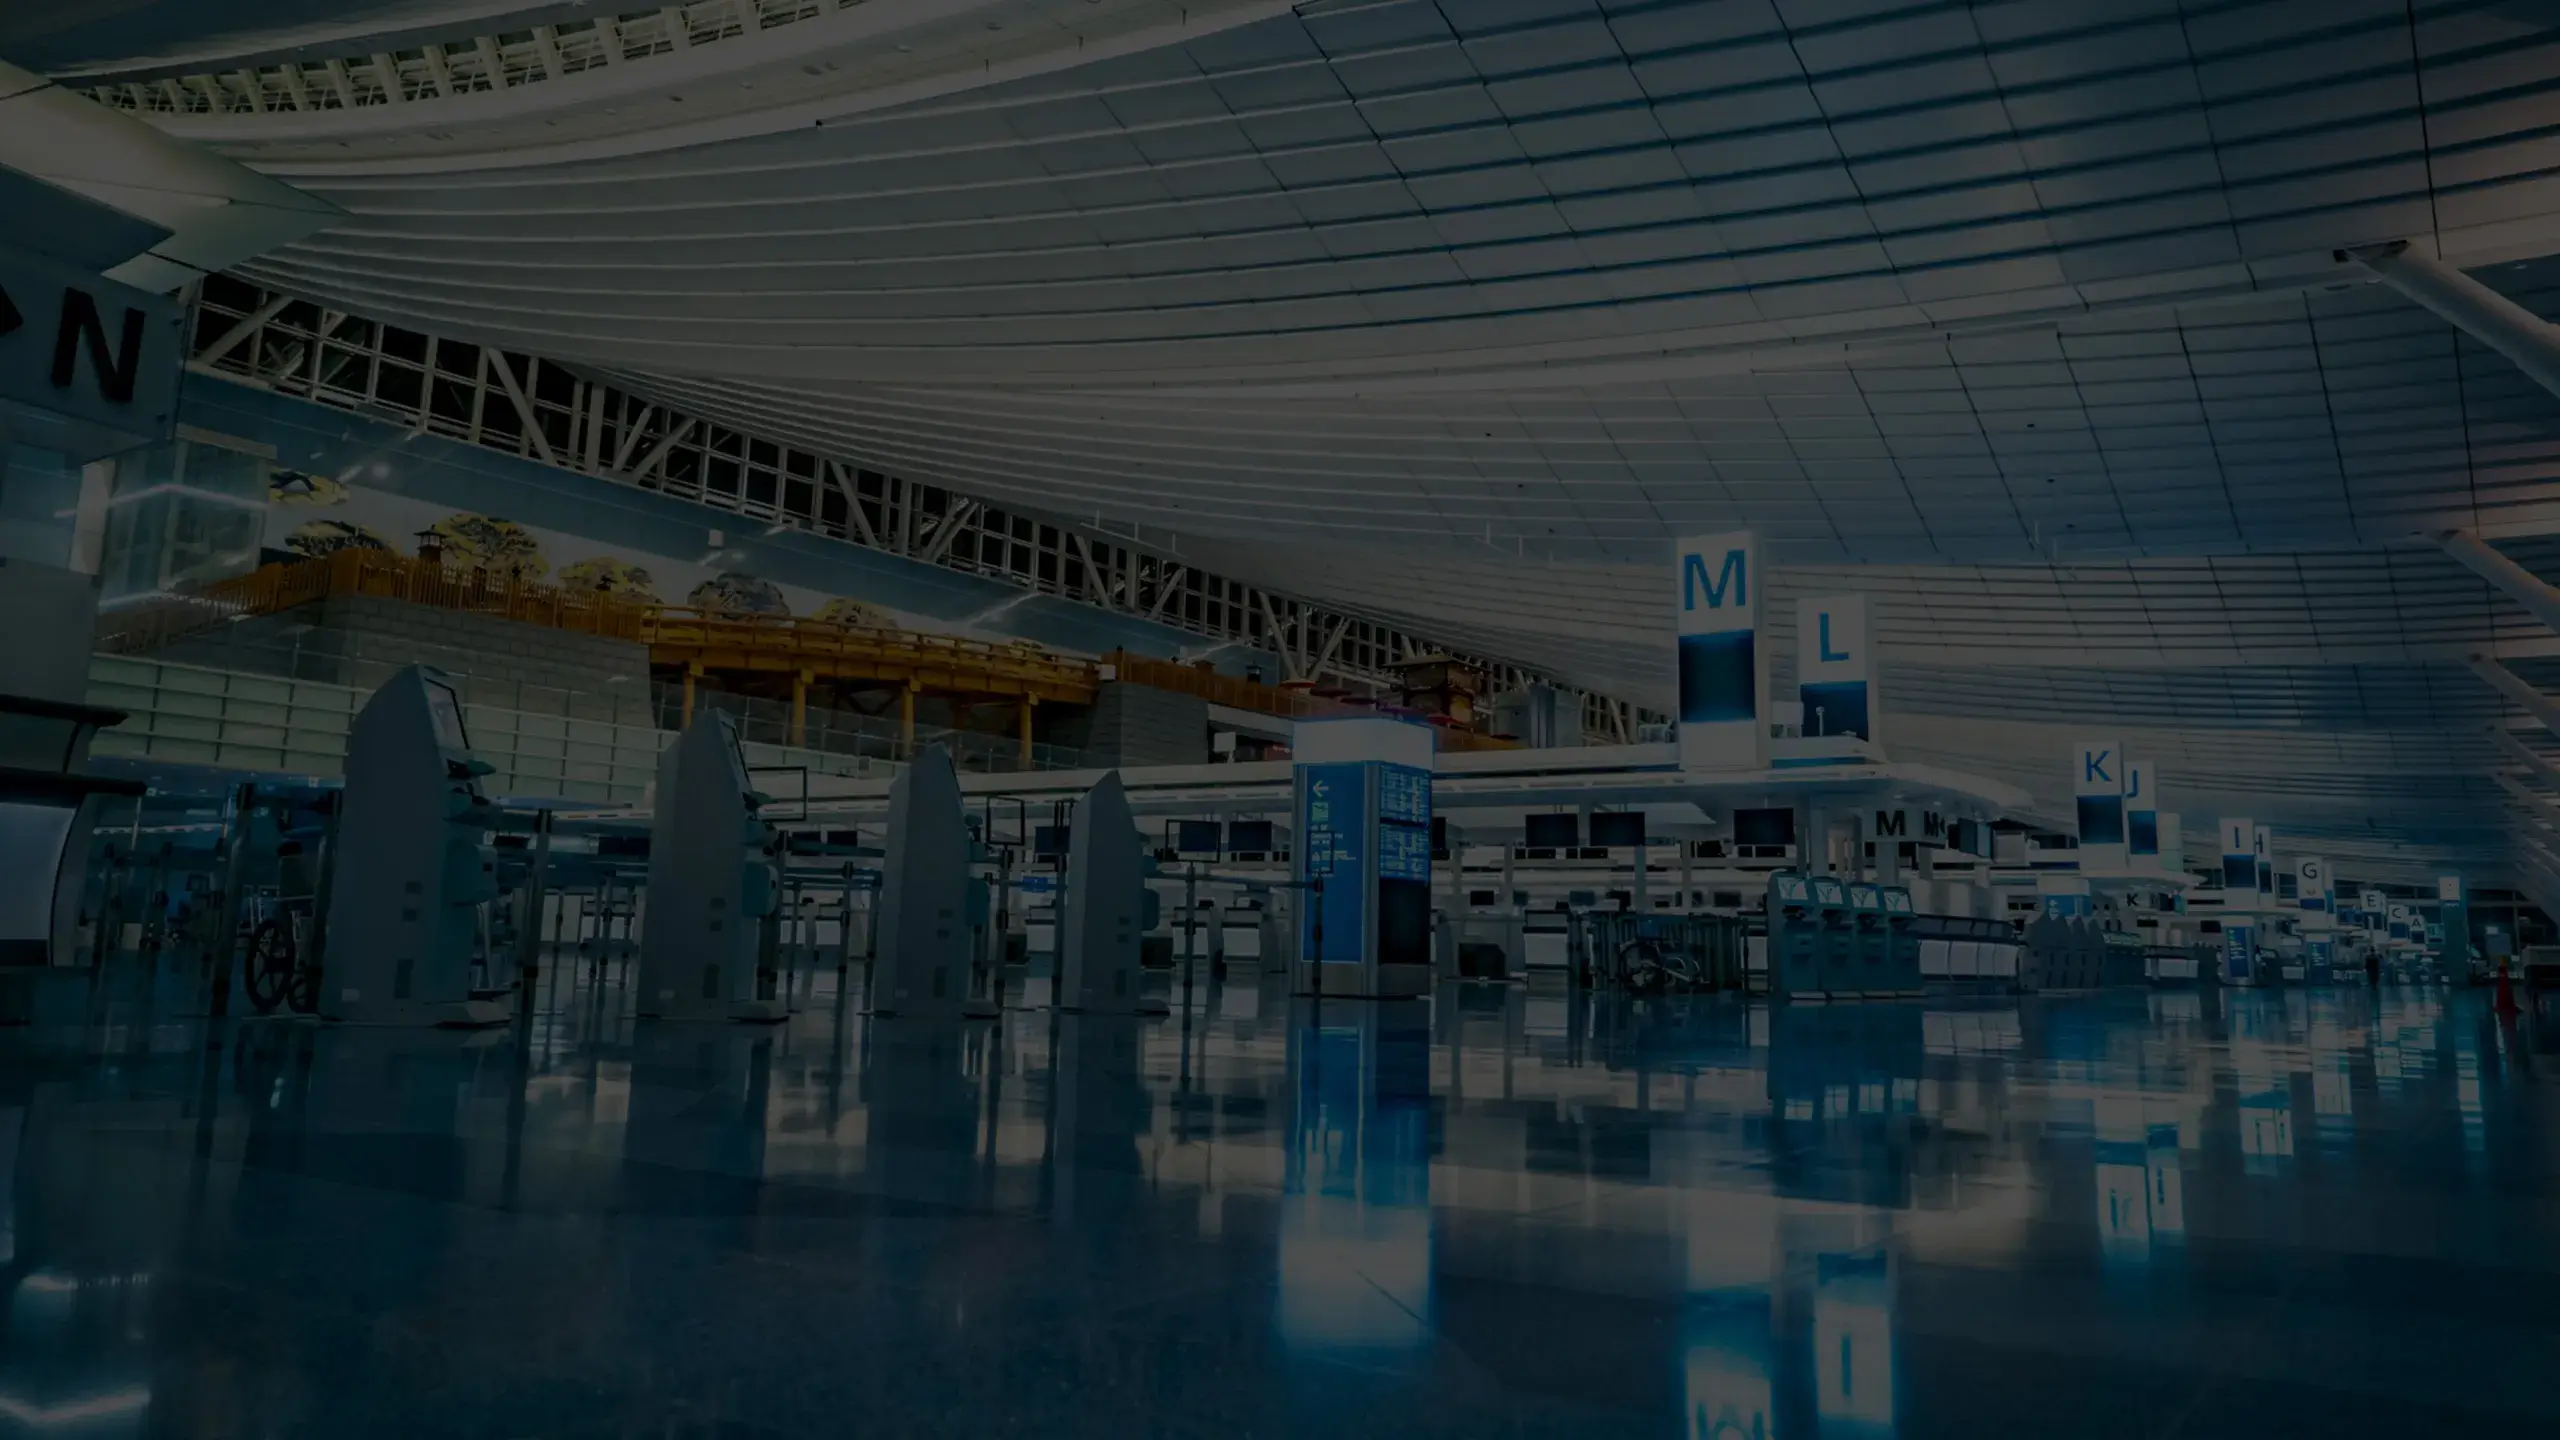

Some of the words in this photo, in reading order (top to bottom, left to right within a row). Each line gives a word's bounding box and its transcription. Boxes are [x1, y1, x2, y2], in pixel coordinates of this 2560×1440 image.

[51, 286, 145, 402] N
[1684, 549, 1746, 610] M
[1819, 612, 1849, 662] L
[2085, 751, 2112, 782] K
[2126, 770, 2138, 797] J
[1876, 810, 1905, 836] M
[2303, 863, 2317, 879] G
[2127, 893, 2138, 906] K
[2366, 895, 2377, 907] E
